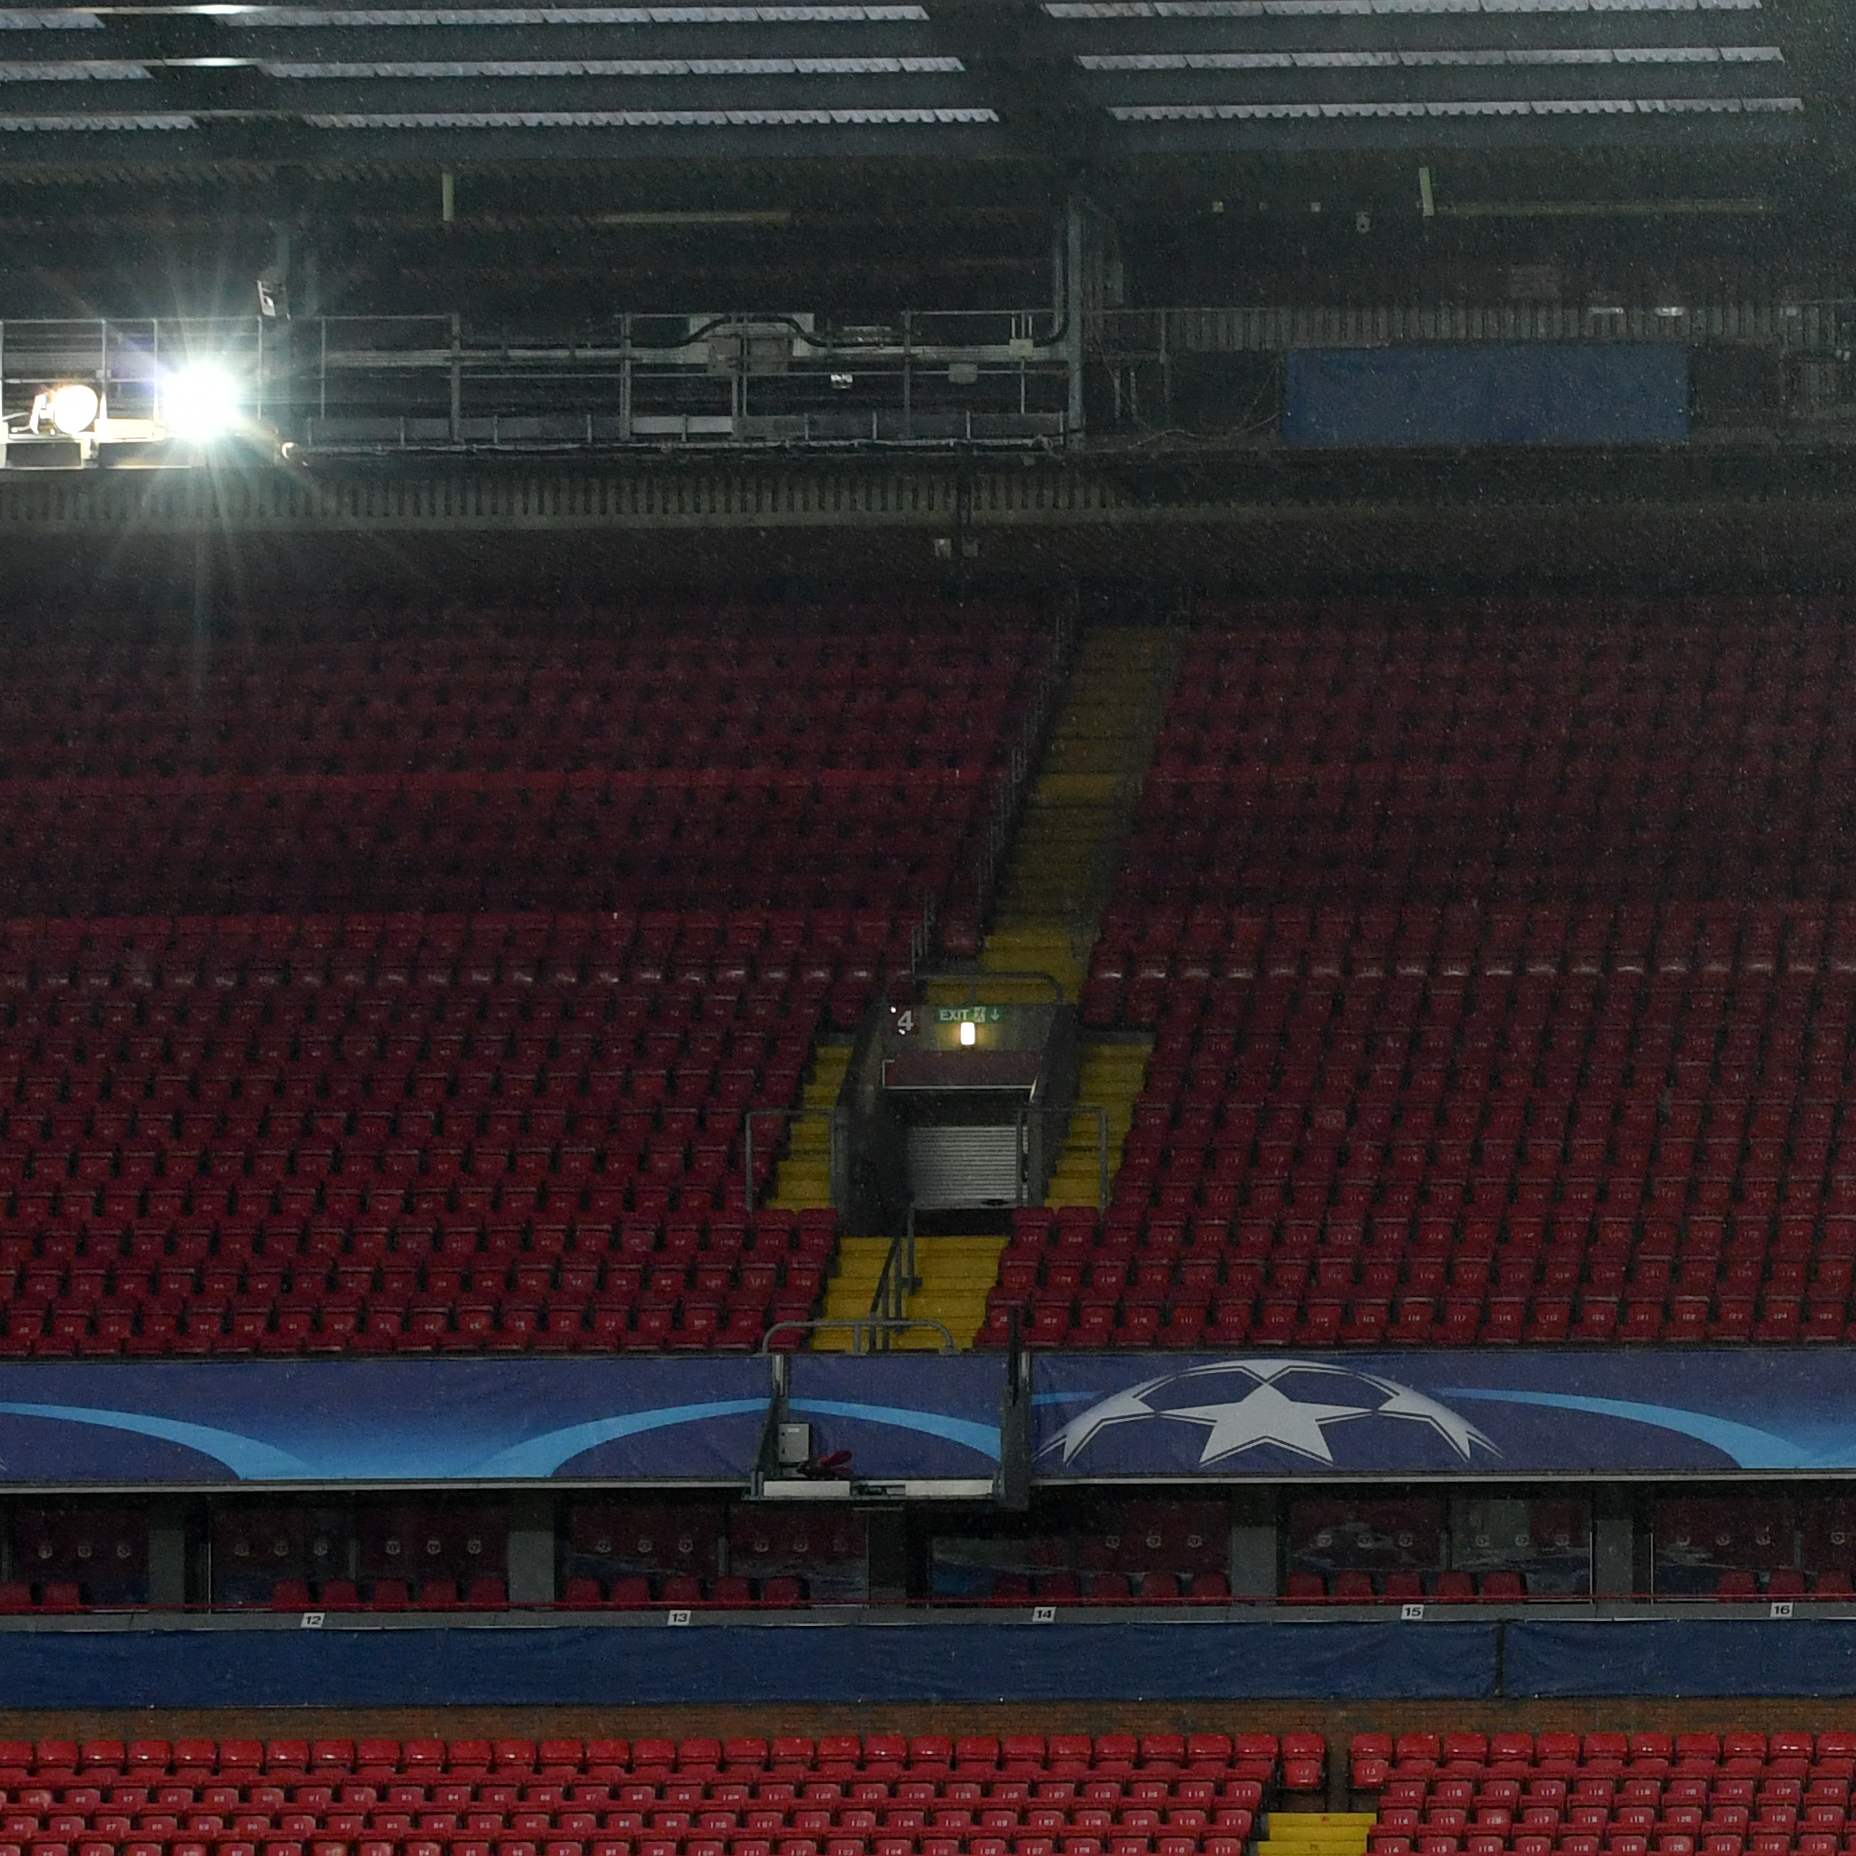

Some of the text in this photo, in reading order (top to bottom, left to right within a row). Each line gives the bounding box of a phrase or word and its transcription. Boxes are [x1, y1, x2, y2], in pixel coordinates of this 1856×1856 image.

[940, 1008, 968, 1021] EXIT
[897, 1010, 914, 1032] 4
[1035, 1610, 1052, 1619] 14
[1404, 1607, 1421, 1616] 15
[1773, 1605, 1790, 1615] 16
[305, 1616, 322, 1625] 12
[671, 1613, 687, 1622] 13
